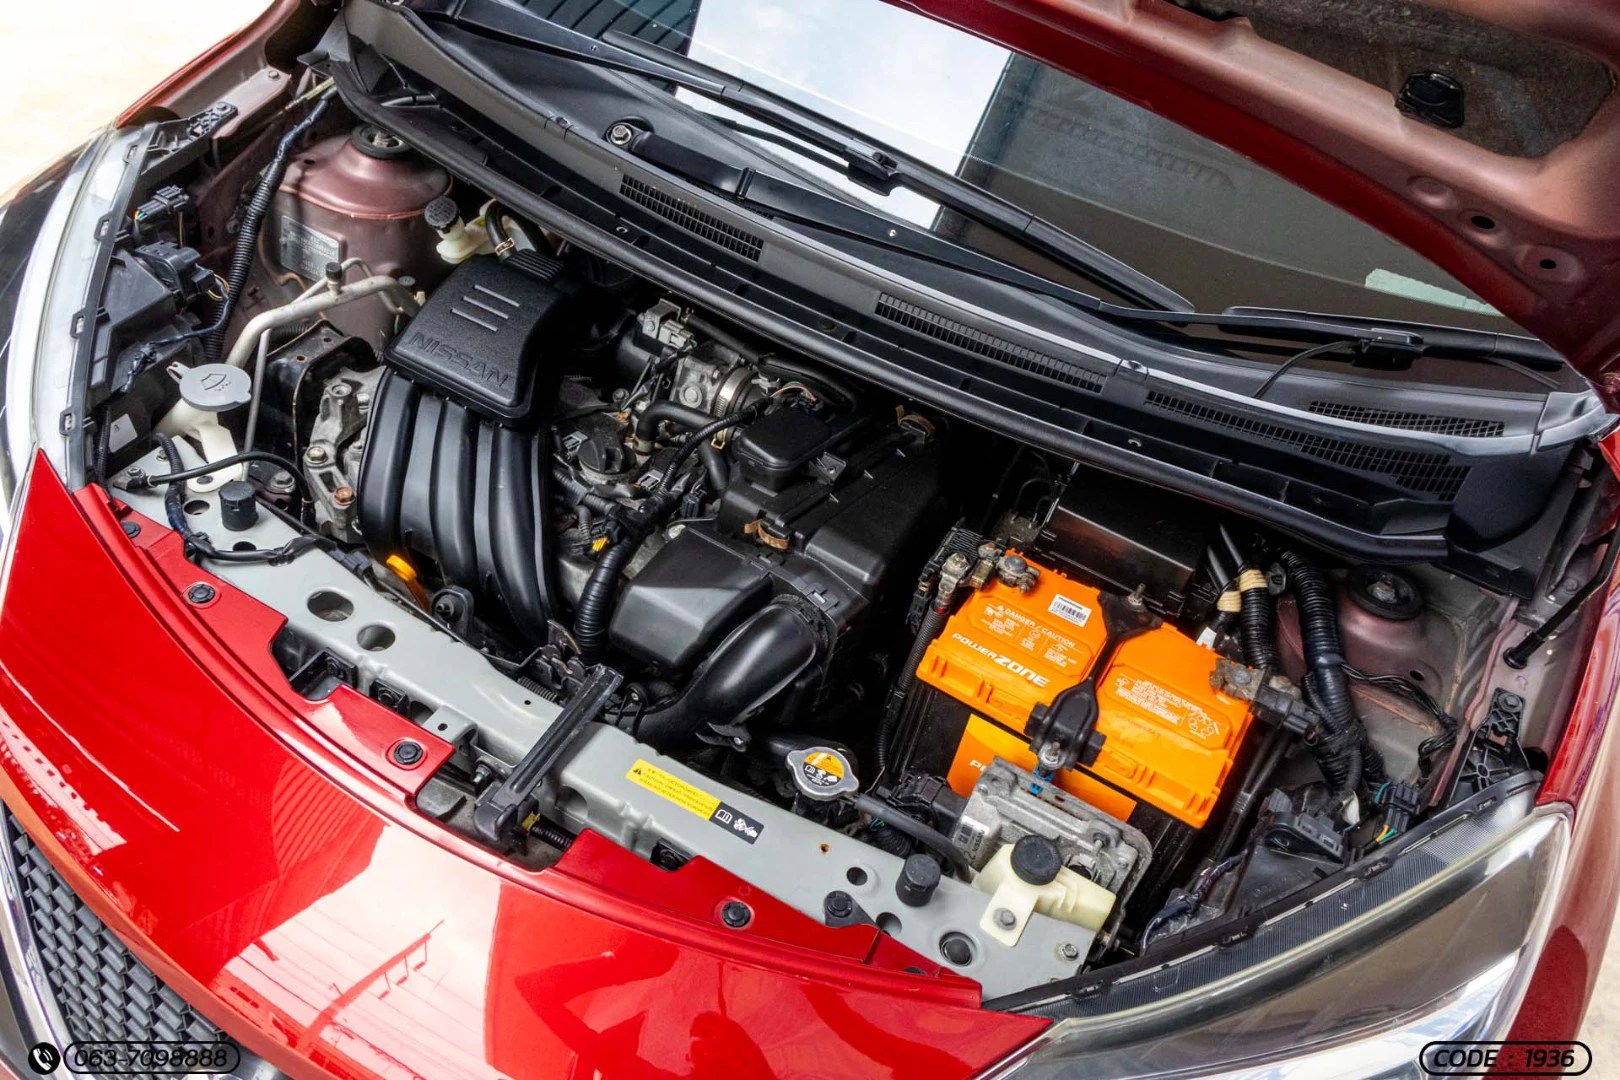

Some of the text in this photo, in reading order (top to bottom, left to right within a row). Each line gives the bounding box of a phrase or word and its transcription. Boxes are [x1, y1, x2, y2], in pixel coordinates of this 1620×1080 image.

[408, 331, 510, 388] NISSAN
[1005, 608, 1036, 628] DANGER
[1041, 627, 1076, 648] CAUTION
